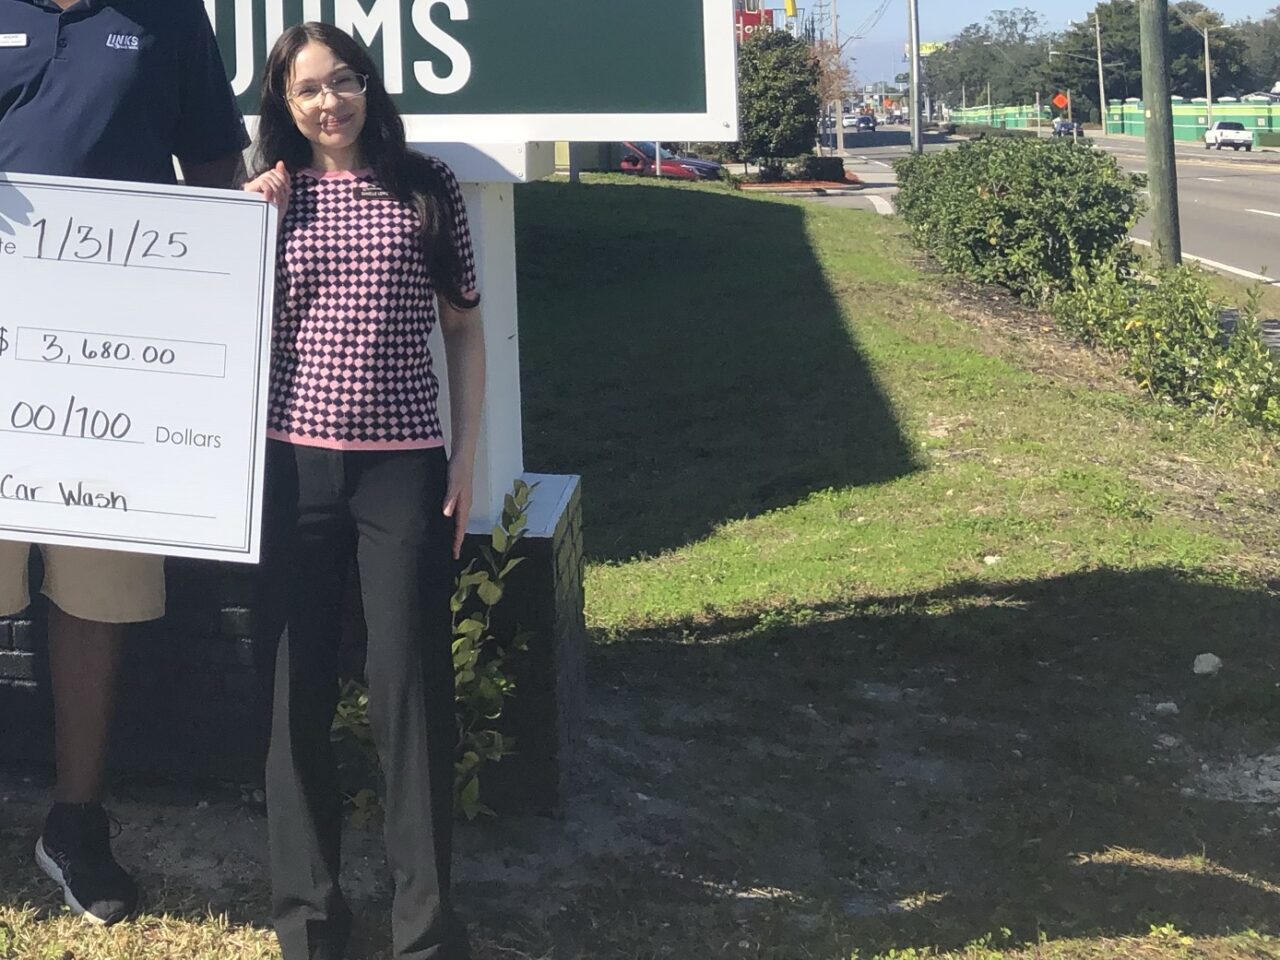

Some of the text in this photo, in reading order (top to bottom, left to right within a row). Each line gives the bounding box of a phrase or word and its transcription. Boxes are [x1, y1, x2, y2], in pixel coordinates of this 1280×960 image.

[106, 34, 139, 48] LINKS
[32, 216, 188, 267] 1/31/25
[10, 395, 132, 440] 00/100
[155, 425, 222, 449] Dollars
[0, 472, 43, 502] Car
[59, 481, 129, 513] Wash
